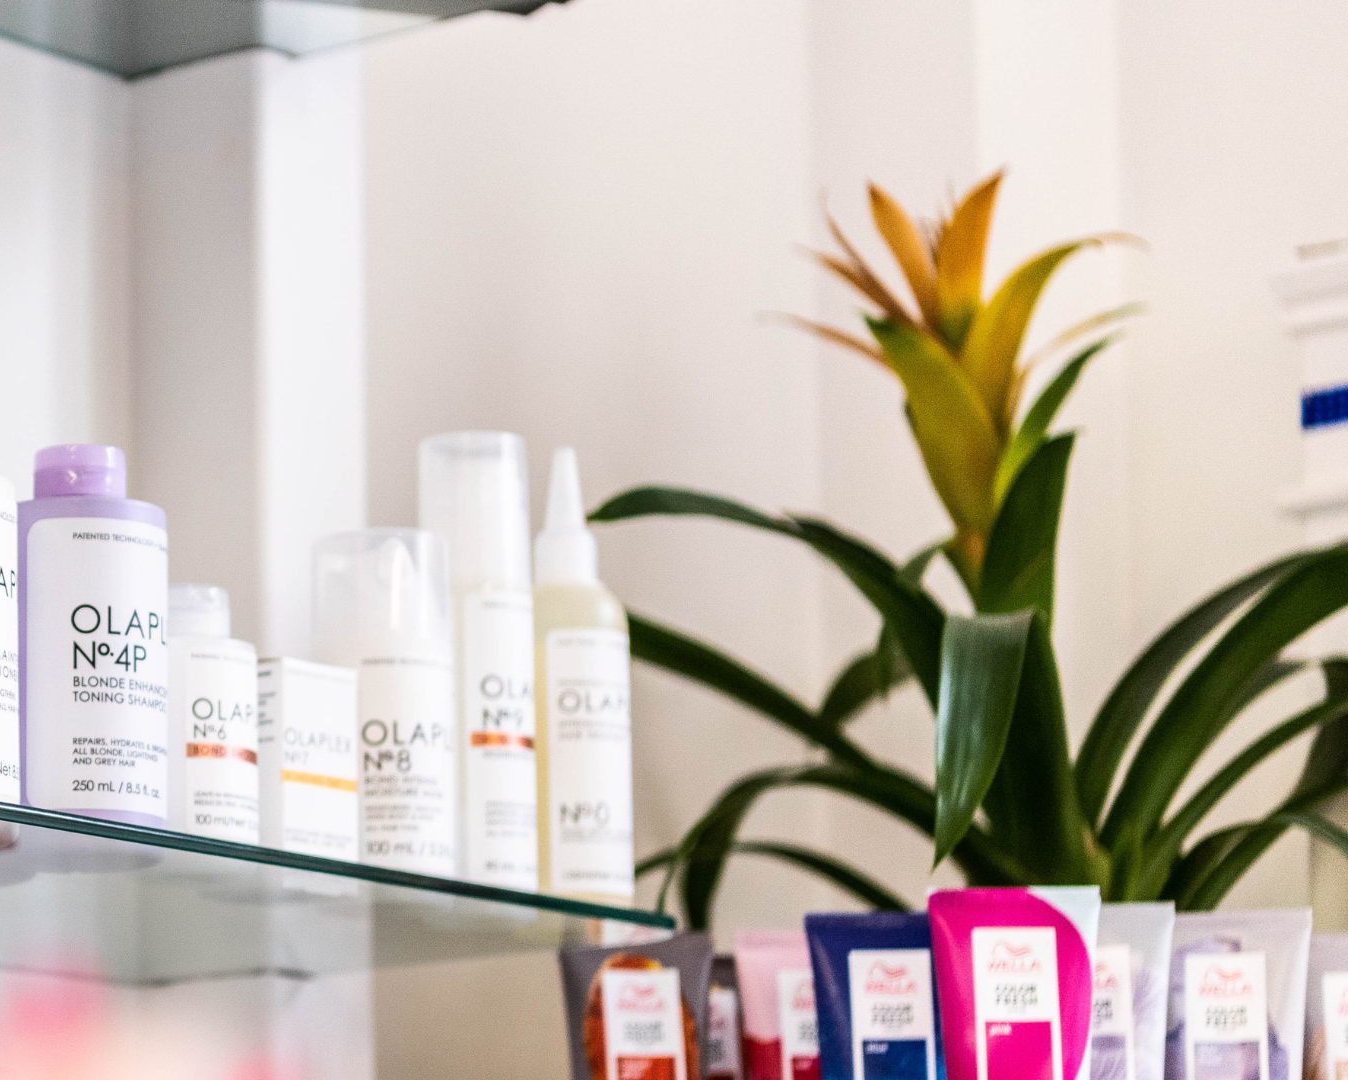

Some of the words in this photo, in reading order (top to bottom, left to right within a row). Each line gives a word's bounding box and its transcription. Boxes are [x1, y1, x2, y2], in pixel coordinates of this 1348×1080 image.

[72, 532, 110, 541] PATENTED
[72, 675, 125, 689] BLONDE
[72, 691, 125, 704] TONING
[110, 738, 145, 749] HYDRATES
[284, 726, 350, 752] OLAPLEX
[72, 747, 87, 755] ALL
[72, 757, 92, 766] AND
[94, 757, 116, 766] GREY
[118, 759, 136, 767] HAIR
[72, 780, 95, 792] 250
[98, 781, 116, 792] mL
[126, 782, 141, 795] 8.5
[195, 814, 212, 825] 100
